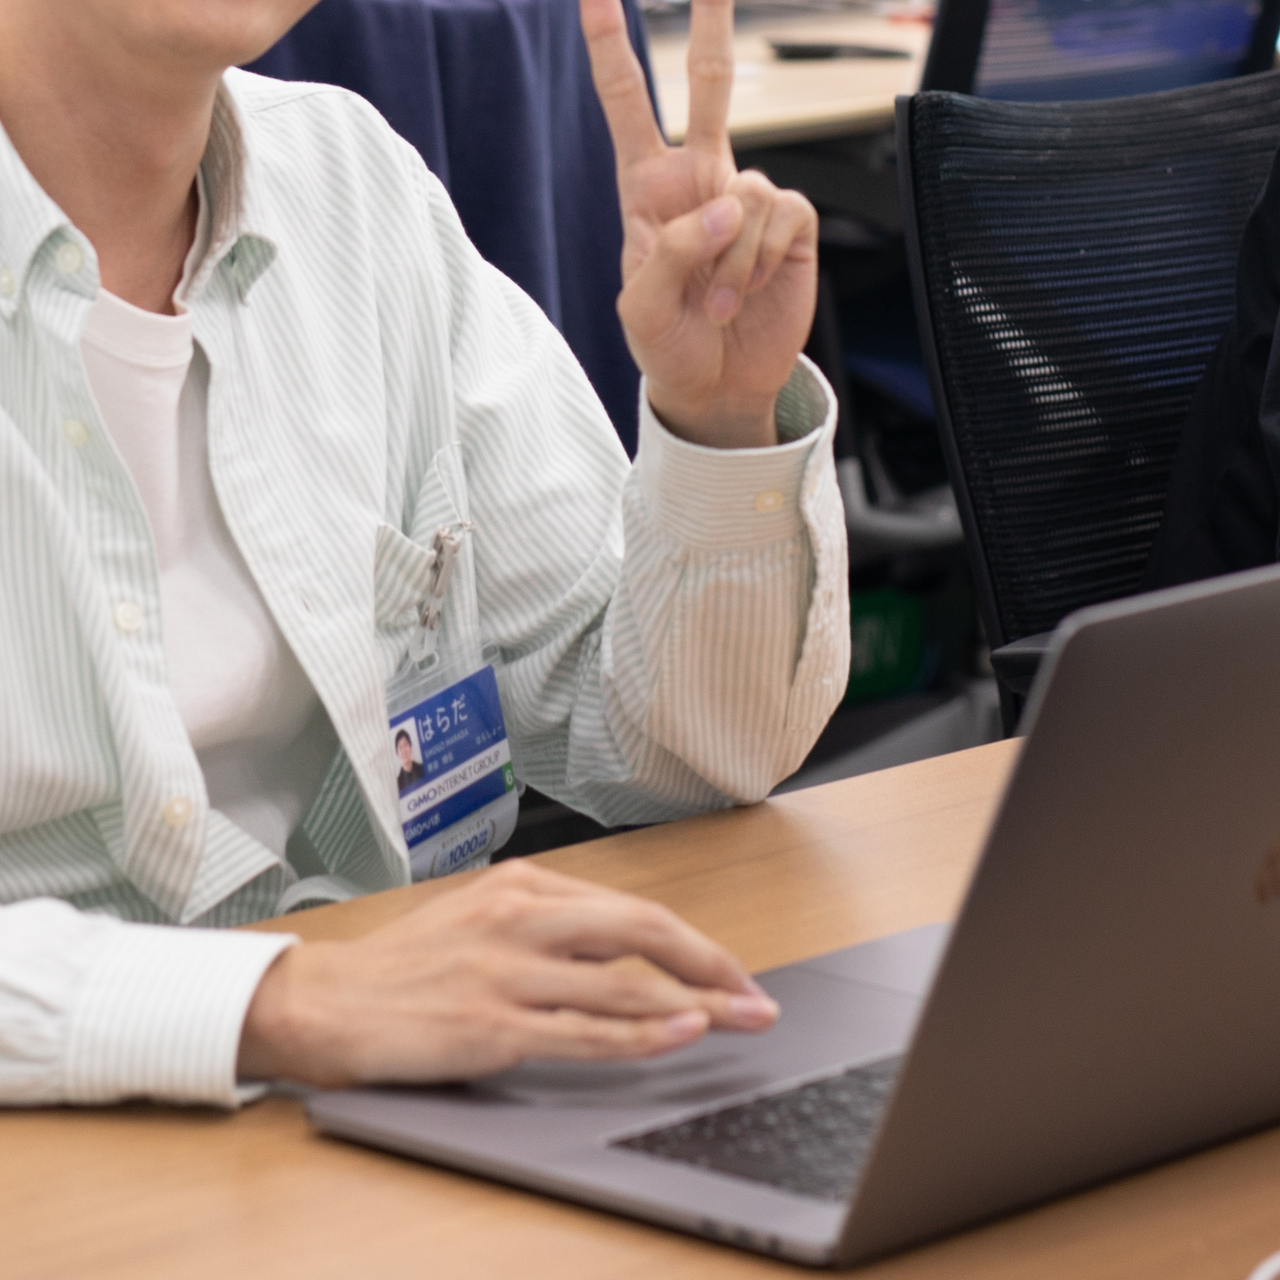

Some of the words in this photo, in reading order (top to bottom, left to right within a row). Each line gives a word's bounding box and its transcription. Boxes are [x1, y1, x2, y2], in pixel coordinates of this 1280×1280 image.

[418, 693, 469, 744] はらだ
[407, 787, 437, 812] GMO
[437, 766, 472, 796] INTERNET
[473, 749, 501, 774] GROUP
[505, 768, 514, 786] 6
